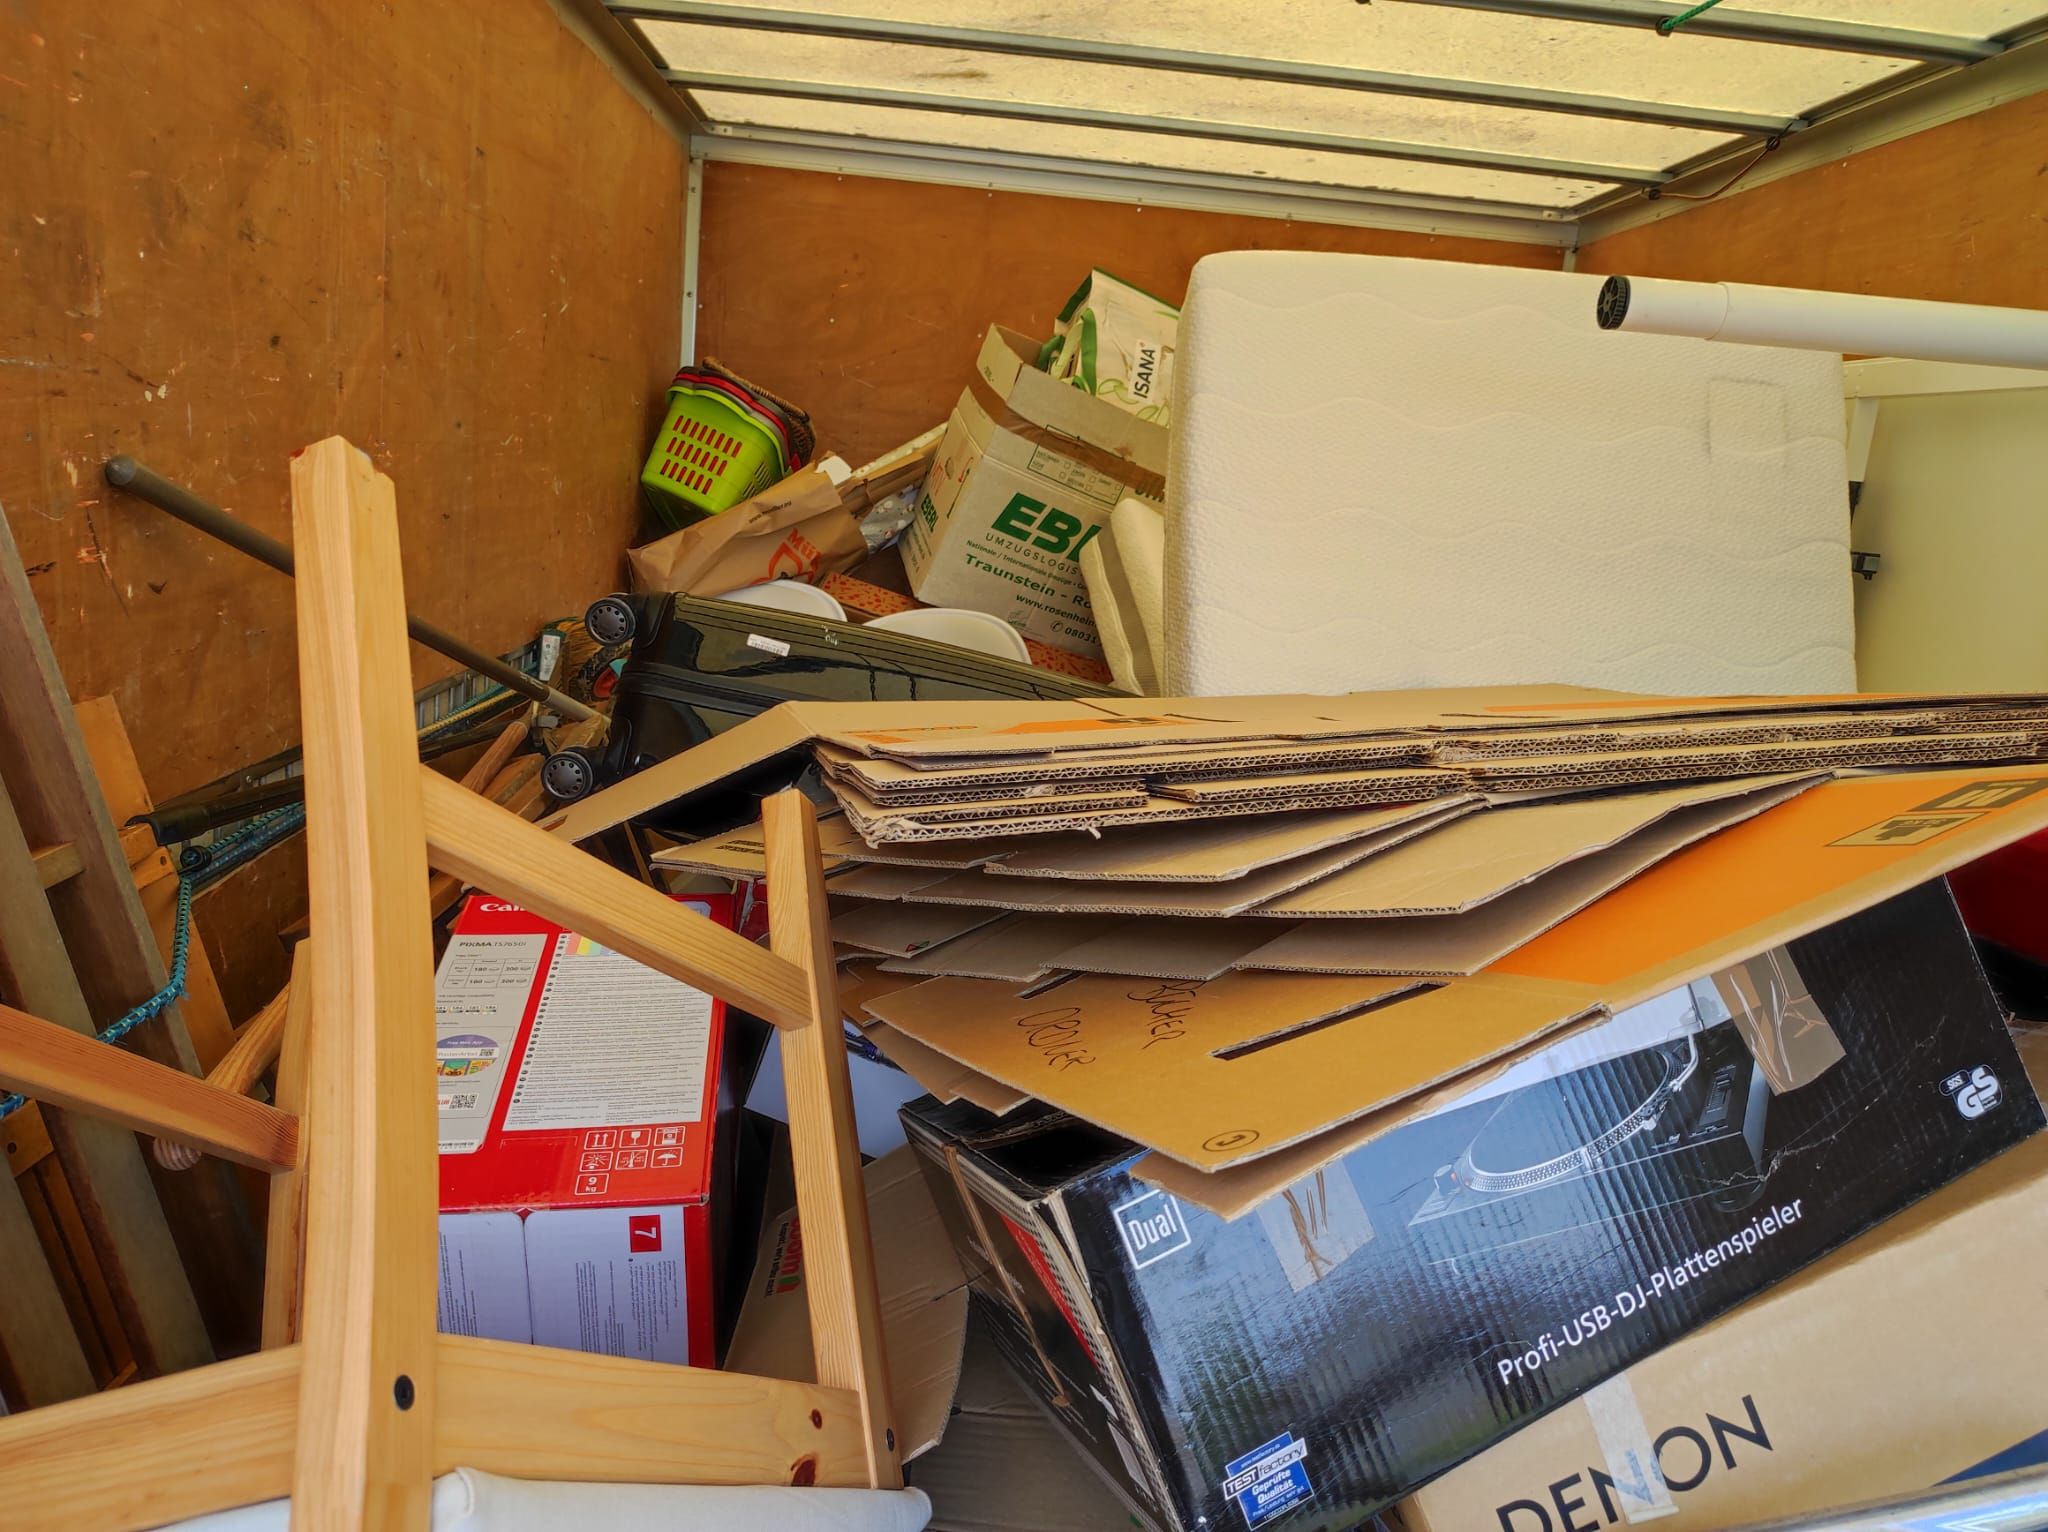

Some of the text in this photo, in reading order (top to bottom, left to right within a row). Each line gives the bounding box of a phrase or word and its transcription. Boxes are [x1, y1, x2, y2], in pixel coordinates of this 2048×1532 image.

[1133, 349, 1156, 399] ISANA
[966, 540, 997, 556] Nationale
[985, 533, 1084, 576] UMZUGSLOGIS
[966, 553, 1056, 597] Traunstein
[588, 1176, 598, 1186] 9
[634, 1227, 657, 1239] 7
[1127, 1203, 1178, 1251] Dual
[1497, 1199, 1803, 1385] Profi-USB-DJ-Plattenspieler
[1226, 1467, 1257, 1494] TEST
[1495, 1394, 1773, 1532] DENON
[1251, 1468, 1292, 1496] Geprüfte
[1257, 1479, 1294, 1505] Qualität
